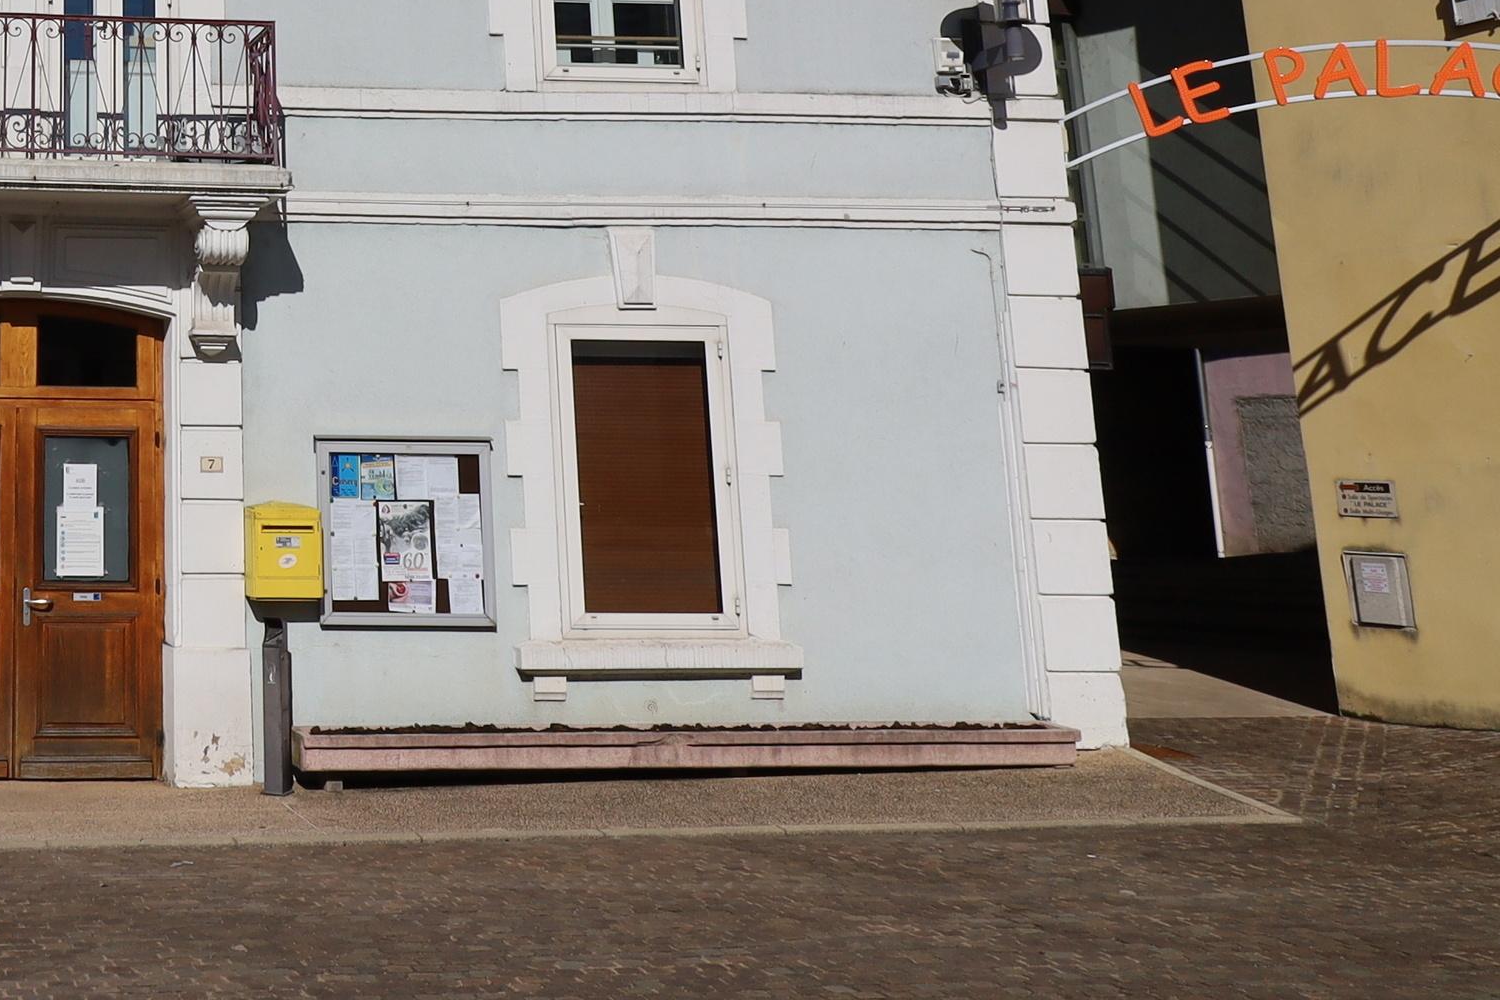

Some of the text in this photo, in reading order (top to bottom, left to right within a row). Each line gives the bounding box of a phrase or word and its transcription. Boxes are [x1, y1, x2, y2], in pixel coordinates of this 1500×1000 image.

[1128, 38, 1500, 138] LE PALA
[207, 458, 215, 469] 7
[1362, 484, 1385, 492] Accès
